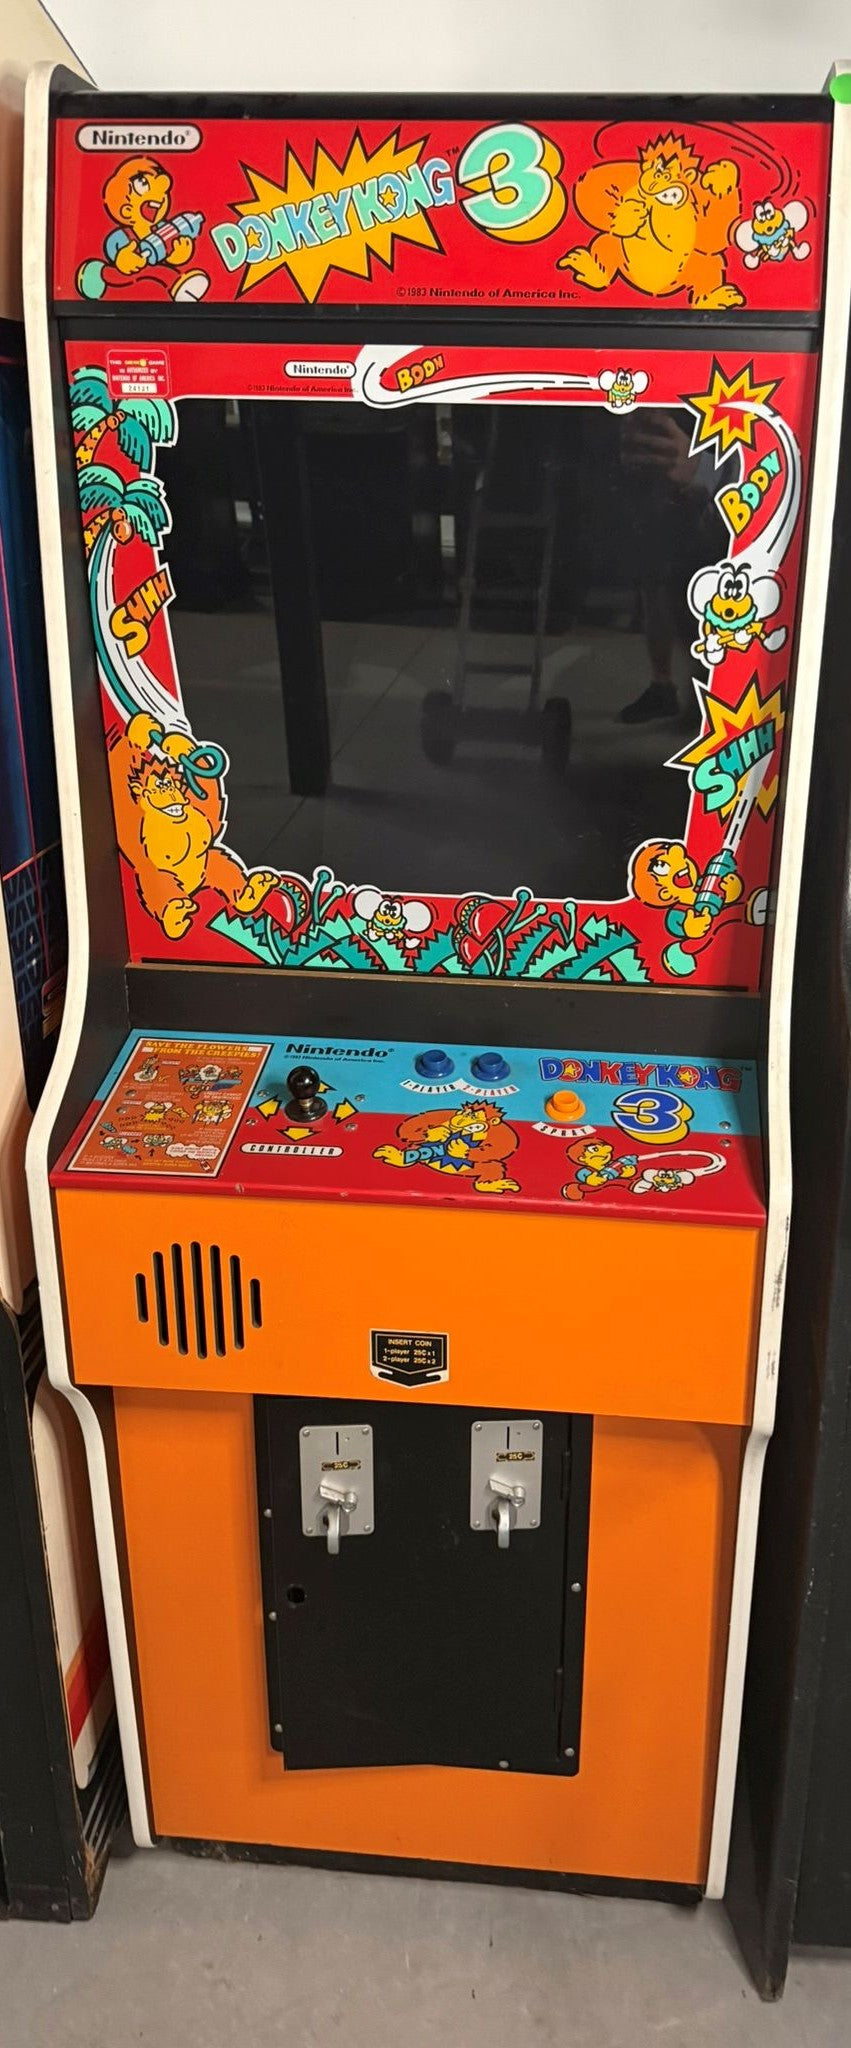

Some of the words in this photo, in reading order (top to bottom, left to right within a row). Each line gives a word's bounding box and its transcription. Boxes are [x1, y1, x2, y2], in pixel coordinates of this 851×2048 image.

[210, 187, 352, 272] DONKEY
[352, 157, 457, 231] KONG
[456, 122, 568, 244] 3
[428, 287, 485, 298] Nintendo
[488, 288, 499, 298] of
[502, 288, 556, 299] America
[558, 289, 582, 299] Inc.
[196, 1043, 250, 1052] FLOWERS
[539, 1057, 657, 1086] DONKEY
[656, 1062, 742, 1093] KONG
[403, 1080, 456, 1093] 1-PLAYER
[463, 1085, 517, 1096] 2-PLAYER
[611, 1088, 694, 1145] 3
[540, 1125, 587, 1137] SPRAY
[250, 1144, 335, 1156] CONTROLLER
[387, 1338, 412, 1346] INSERT
[414, 1339, 432, 1347] COIN
[384, 1348, 410, 1356] 1-player
